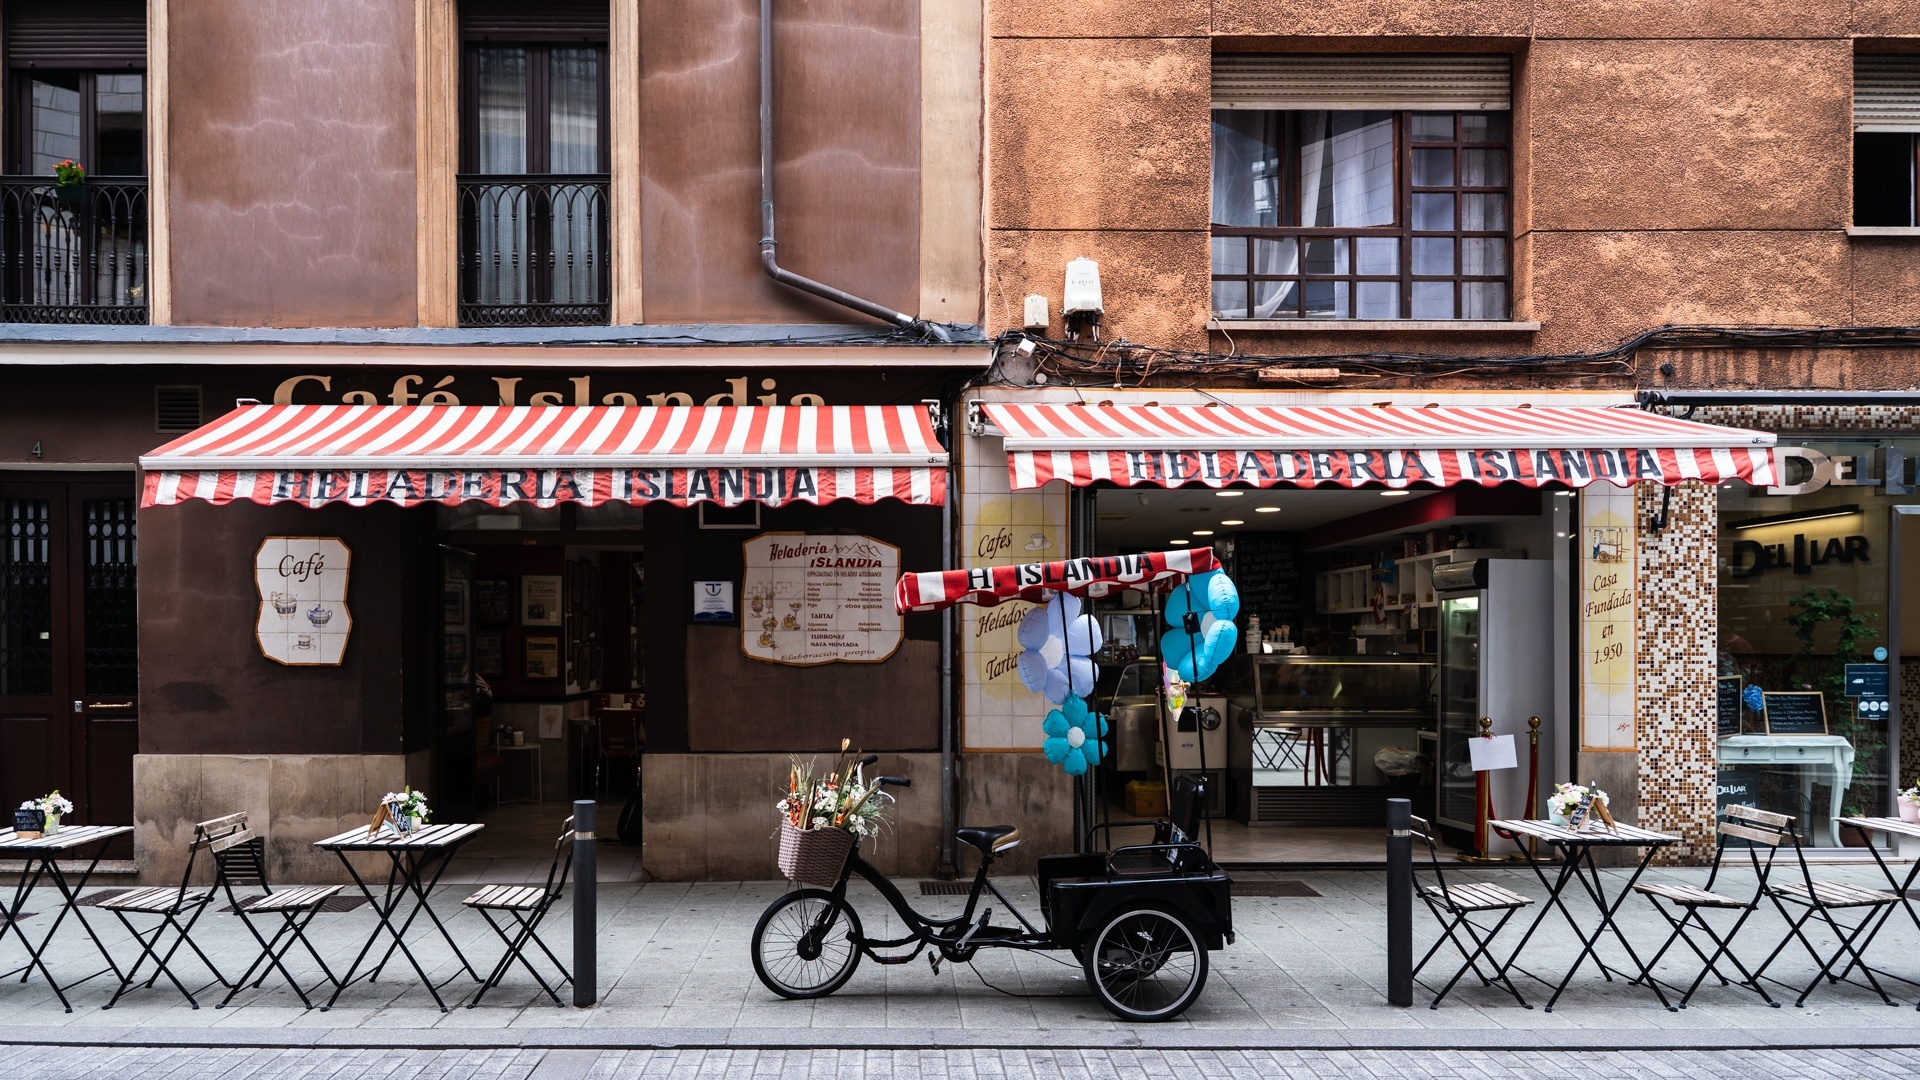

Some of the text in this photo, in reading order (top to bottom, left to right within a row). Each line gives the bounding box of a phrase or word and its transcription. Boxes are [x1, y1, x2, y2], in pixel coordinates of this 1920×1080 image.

[32, 440, 42, 458] 4
[1127, 448, 1663, 480] HELADERIA ISLANDIA
[272, 468, 817, 500] HELADERIA ISLANDIA
[1886, 447, 1920, 495] L
[978, 528, 1013, 559] Cafes
[278, 552, 326, 582] Café
[810, 557, 882, 568] ISLANDIA
[966, 553, 1154, 590] H. ISLANDIA
[1593, 572, 1618, 592] Casa
[1586, 588, 1632, 618] Fundada
[1602, 622, 1614, 640] en
[780, 649, 875, 661] Elaboración propia
[986, 650, 1023, 682] Tarta
[1594, 642, 1623, 666] 1.950
